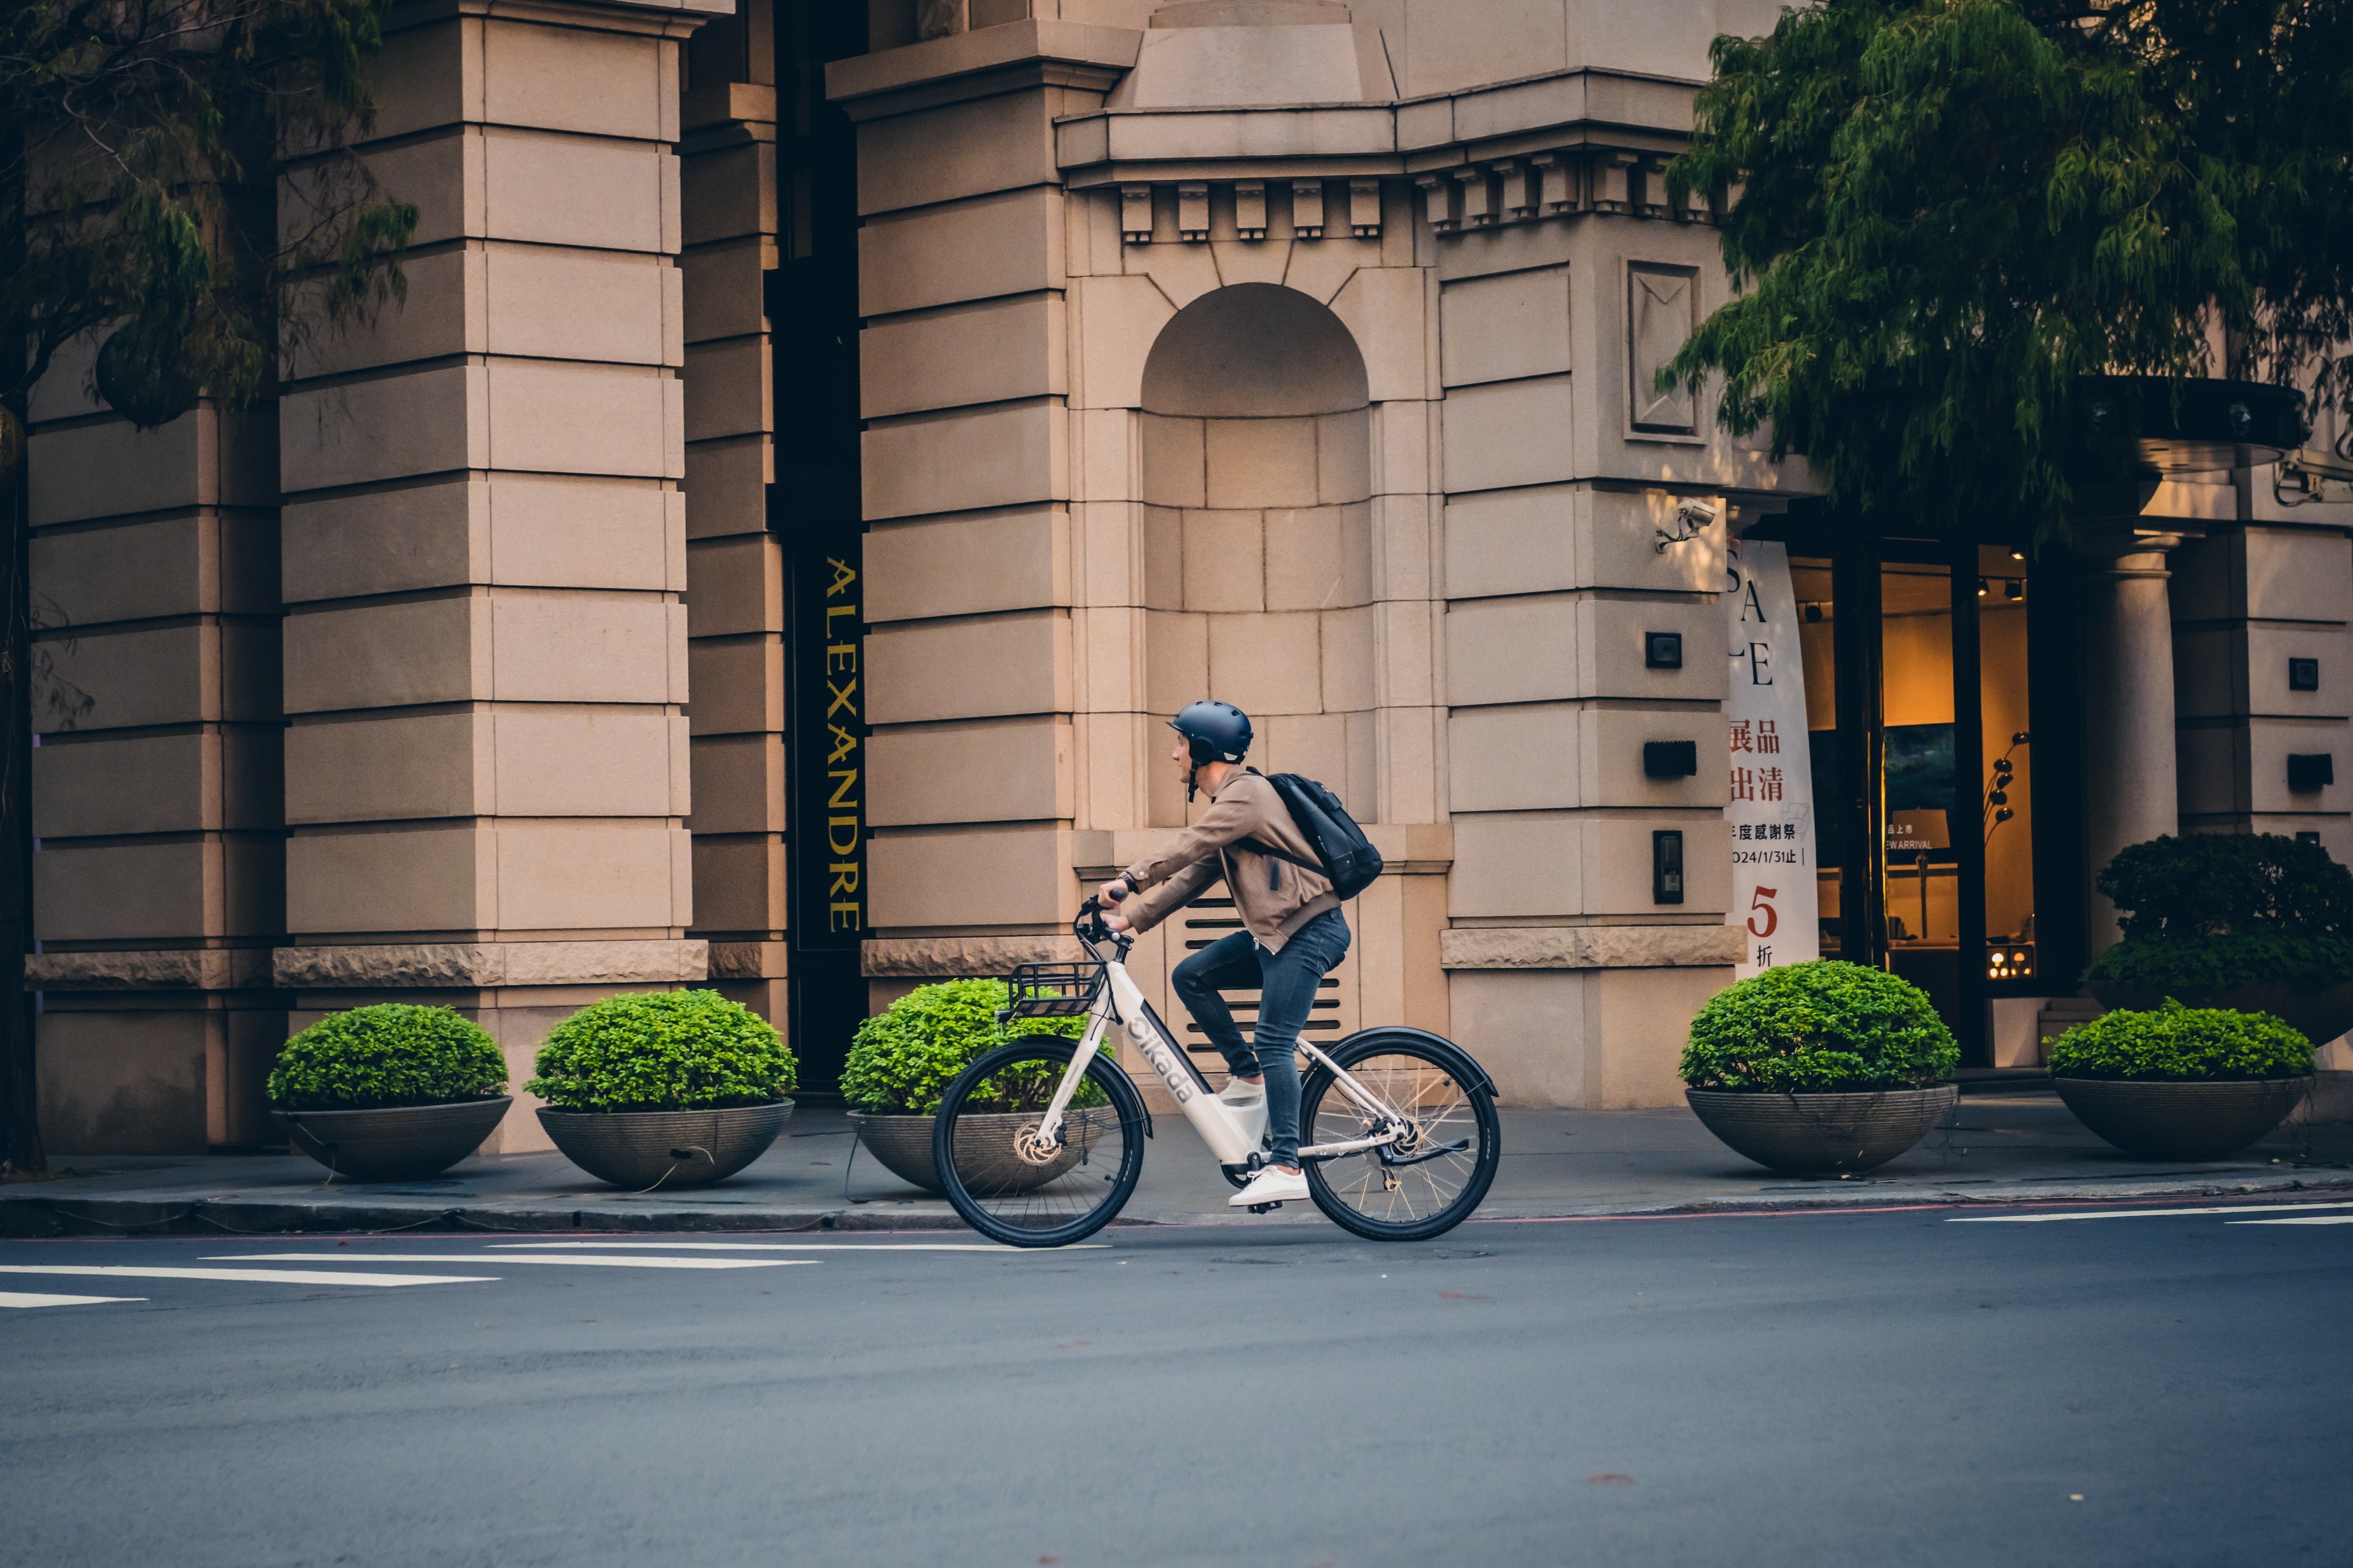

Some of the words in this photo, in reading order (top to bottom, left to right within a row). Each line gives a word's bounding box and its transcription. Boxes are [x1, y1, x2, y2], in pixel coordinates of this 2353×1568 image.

[826, 556, 860, 933] ALEXANDRE
[1730, 719, 1780, 754] 展品
[1730, 767, 1784, 802] 出清
[1732, 823, 1795, 840] 度感謝祭
[1897, 840, 1932, 849] ARRIVAL
[1747, 885, 1778, 938] 5
[1757, 945, 1772, 967] 折
[1128, 1017, 1194, 1104] Cikada
